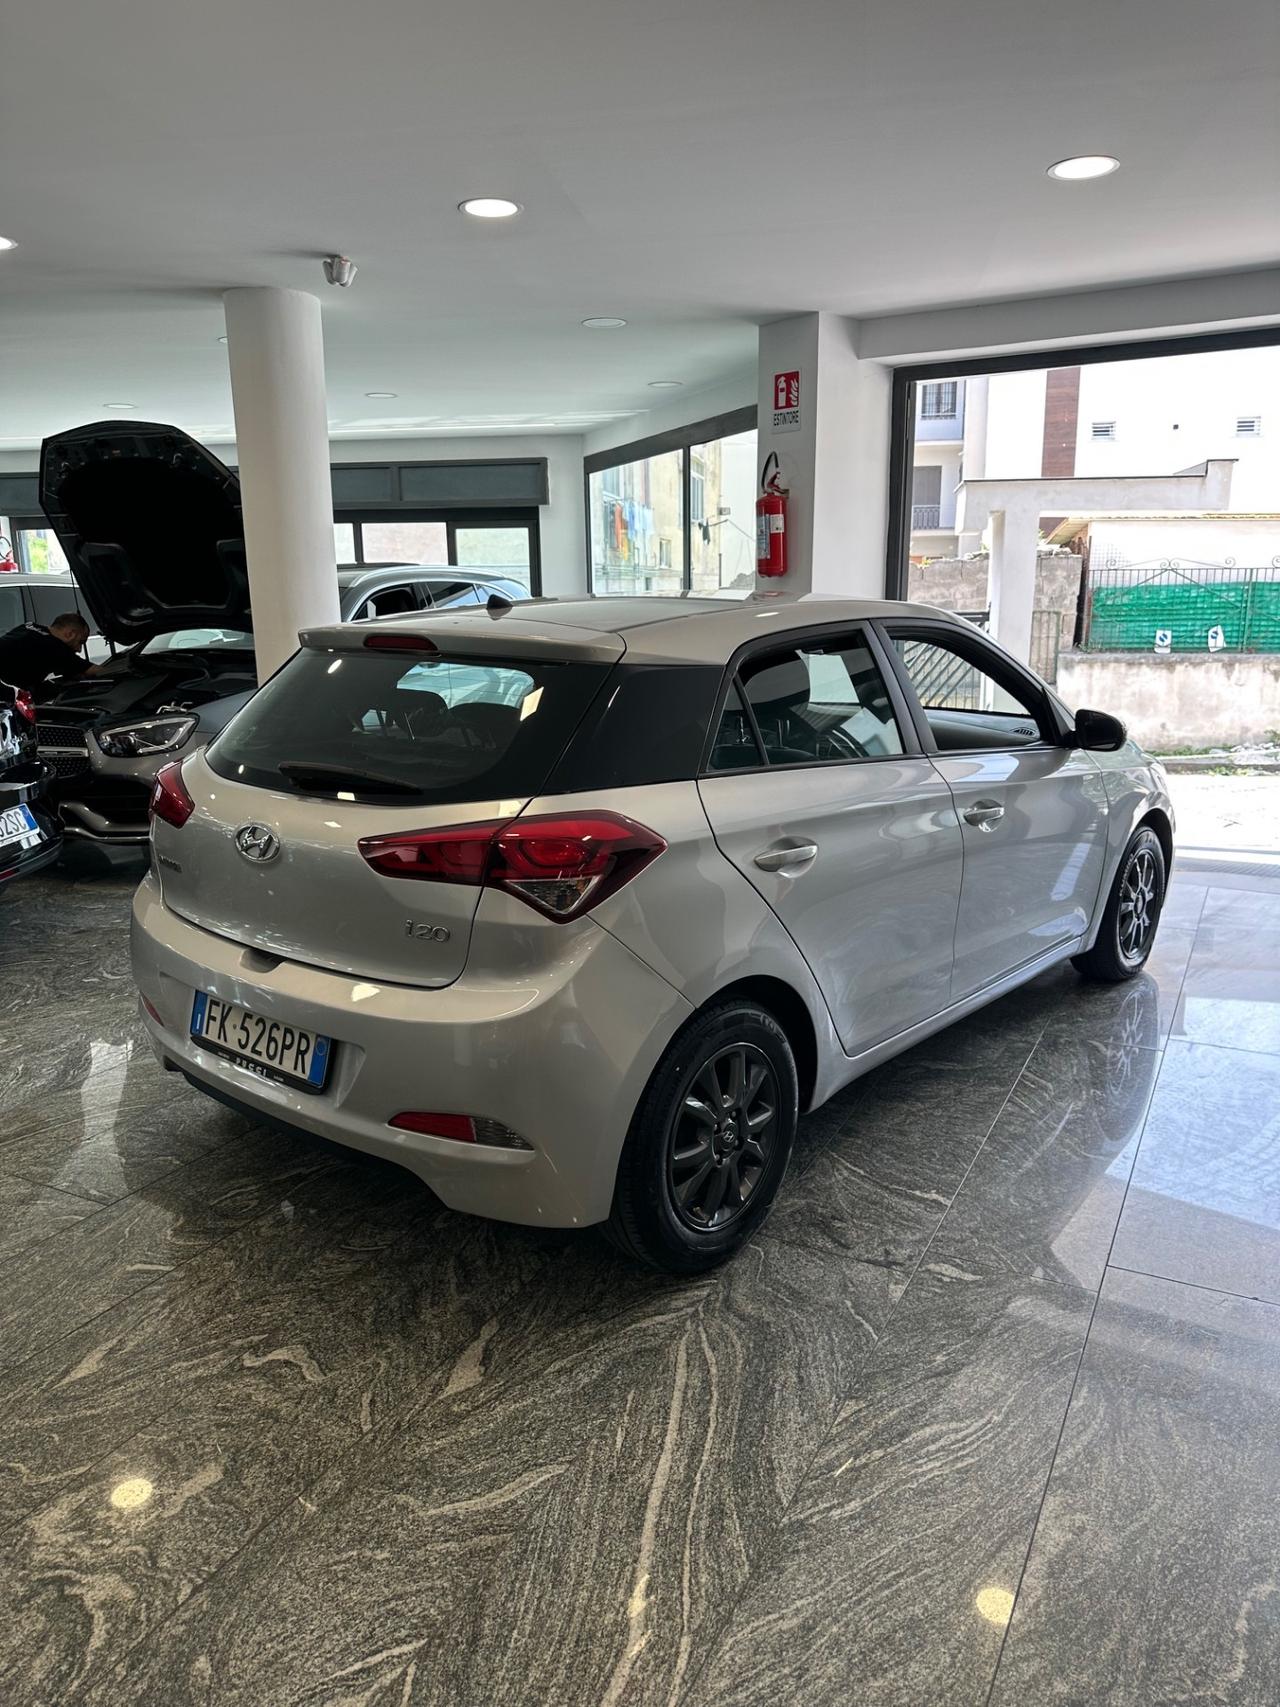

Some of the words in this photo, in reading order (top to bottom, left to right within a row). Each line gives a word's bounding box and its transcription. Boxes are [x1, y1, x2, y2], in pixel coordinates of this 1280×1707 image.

[773, 410, 799, 427] ESTINTORE
[405, 919, 451, 943] i20
[206, 999, 232, 1043] FK
[237, 1013, 310, 1075] 526PR
